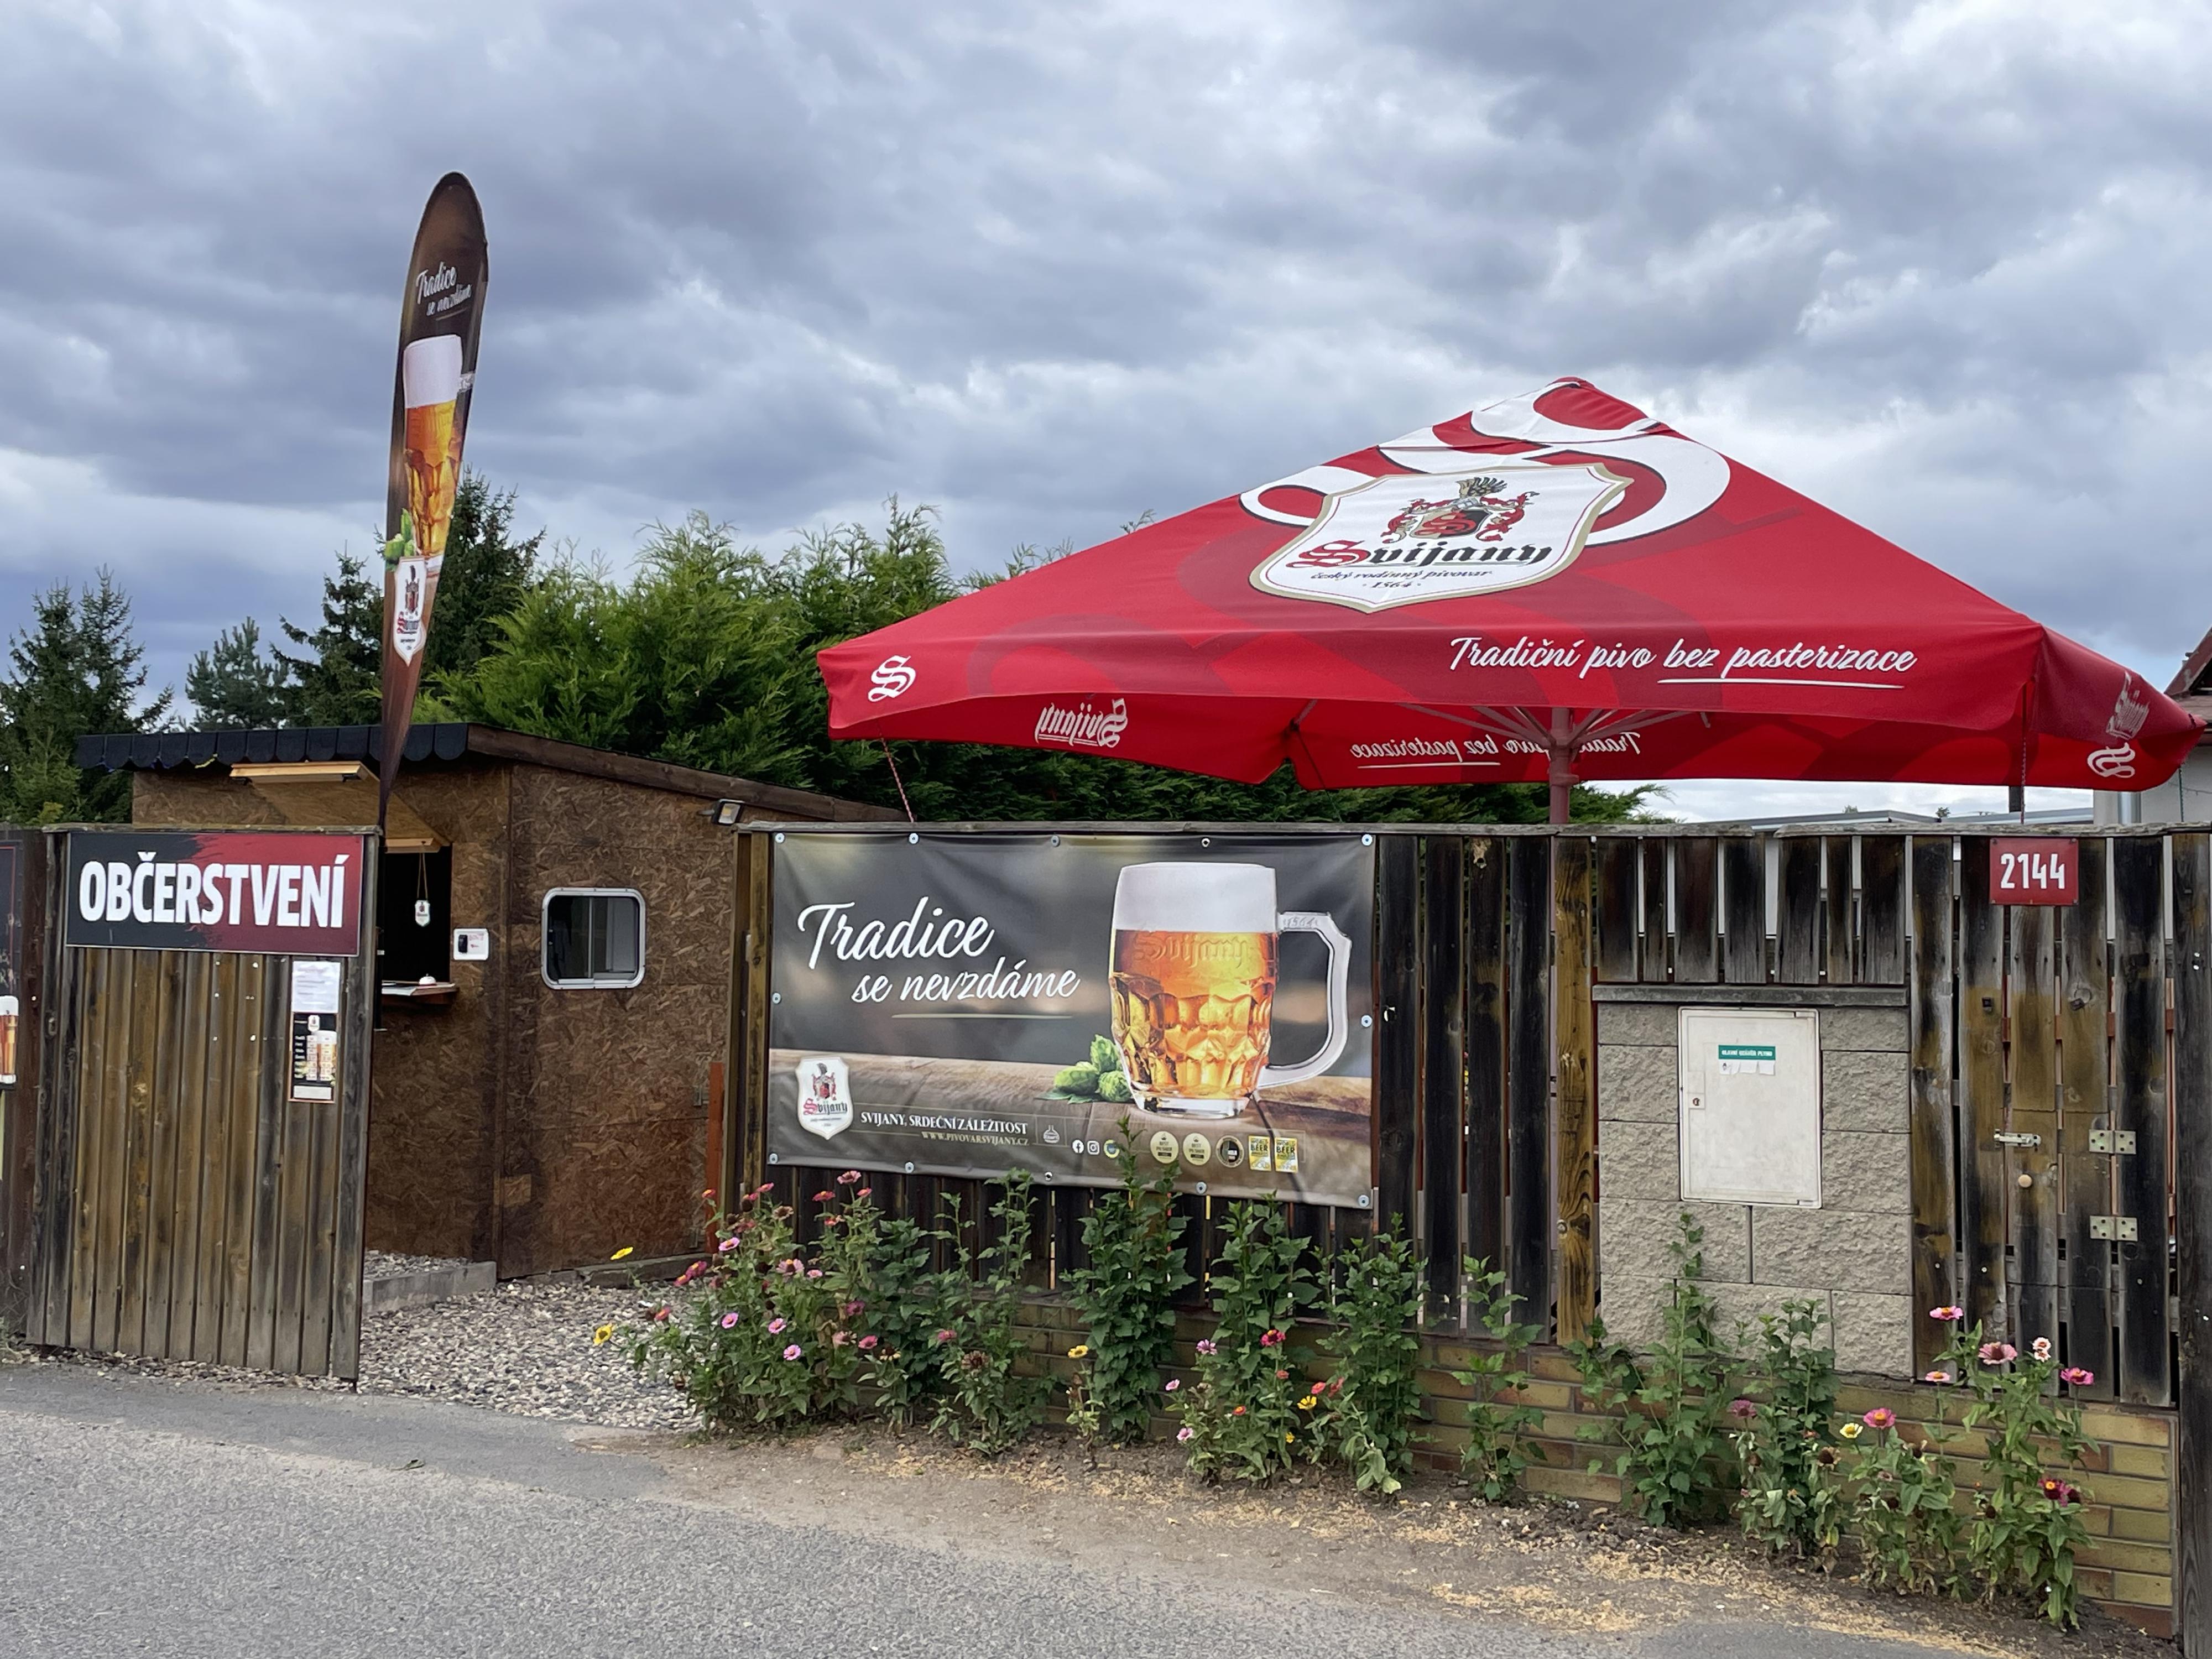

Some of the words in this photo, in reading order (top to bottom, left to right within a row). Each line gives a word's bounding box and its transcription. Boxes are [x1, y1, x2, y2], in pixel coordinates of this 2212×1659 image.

[1285, 540, 1552, 567] Svijany
[1423, 570, 1493, 580] pivovar
[868, 655, 916, 702] S
[1449, 637, 1585, 671] Tradiční
[1578, 640, 1657, 680] pivo
[1662, 638, 1720, 669] bez
[1721, 642, 1918, 679] pasterizace
[79, 851, 350, 927] OBČERSTVENÍ
[2000, 853, 2065, 889] 2144
[797, 896, 995, 970] Tradice
[851, 974, 893, 1003] se
[900, 956, 1081, 1001] nevzdáme
[860, 1112, 907, 1126] SVIJANY,
[909, 1115, 957, 1130] SRDEČNÍ
[957, 1117, 1028, 1135] ZÁLEŽITOST
